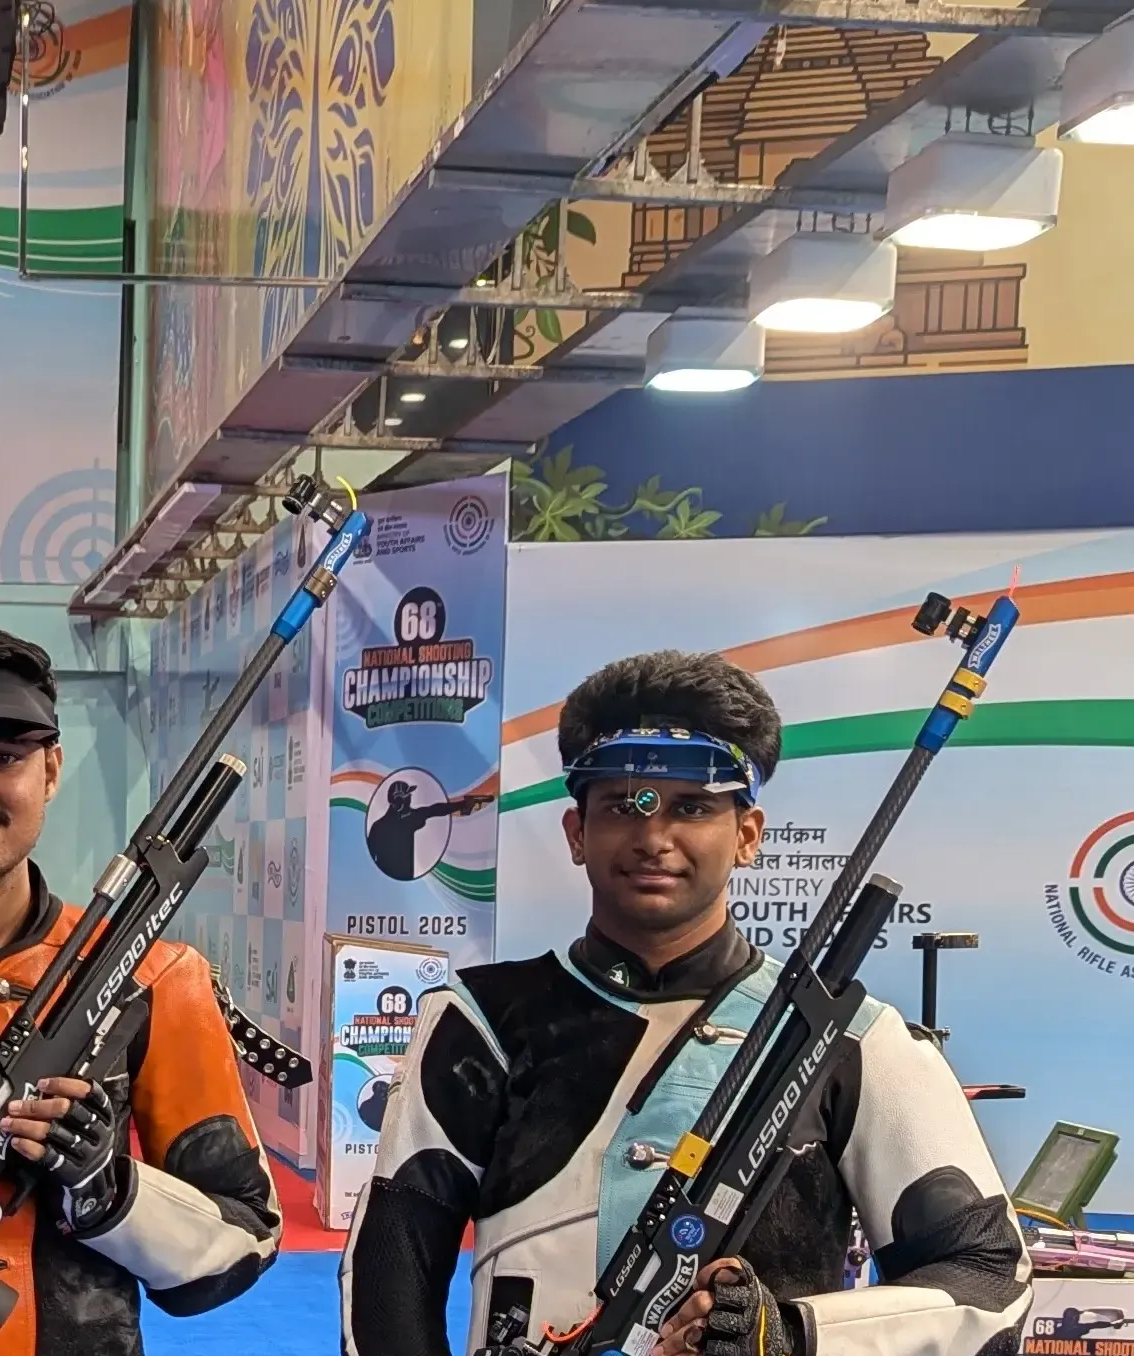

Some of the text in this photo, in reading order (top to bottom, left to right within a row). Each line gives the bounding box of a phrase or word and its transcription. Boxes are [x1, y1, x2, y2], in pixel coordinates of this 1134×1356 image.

[401, 600, 437, 641] 68
[363, 646, 415, 666] NATIONAL
[344, 657, 492, 709] CHAMPIONSHIP
[367, 699, 464, 727] COMPETITIONS
[727, 901, 808, 922] OUTH
[1044, 884, 1077, 948] NATIONAL
[347, 915, 467, 936] PISTOL 2025
[86, 882, 183, 1026] LG500 itec
[1077, 946, 1116, 974] RIFLE
[381, 993, 407, 1014] 68
[354, 1016, 418, 1025] NATIONAL SHOOT
[342, 1025, 412, 1045] CHAMPION
[358, 1043, 405, 1055] COMPETIT
[738, 1019, 839, 1187] LG500 itec
[345, 1143, 378, 1154] PISTO
[610, 1244, 641, 1297] LG500
[647, 1265, 694, 1325] WALTHER
[1035, 1319, 1055, 1335] 68
[1026, 1339, 1134, 1356] NATIONAL SHOOT
